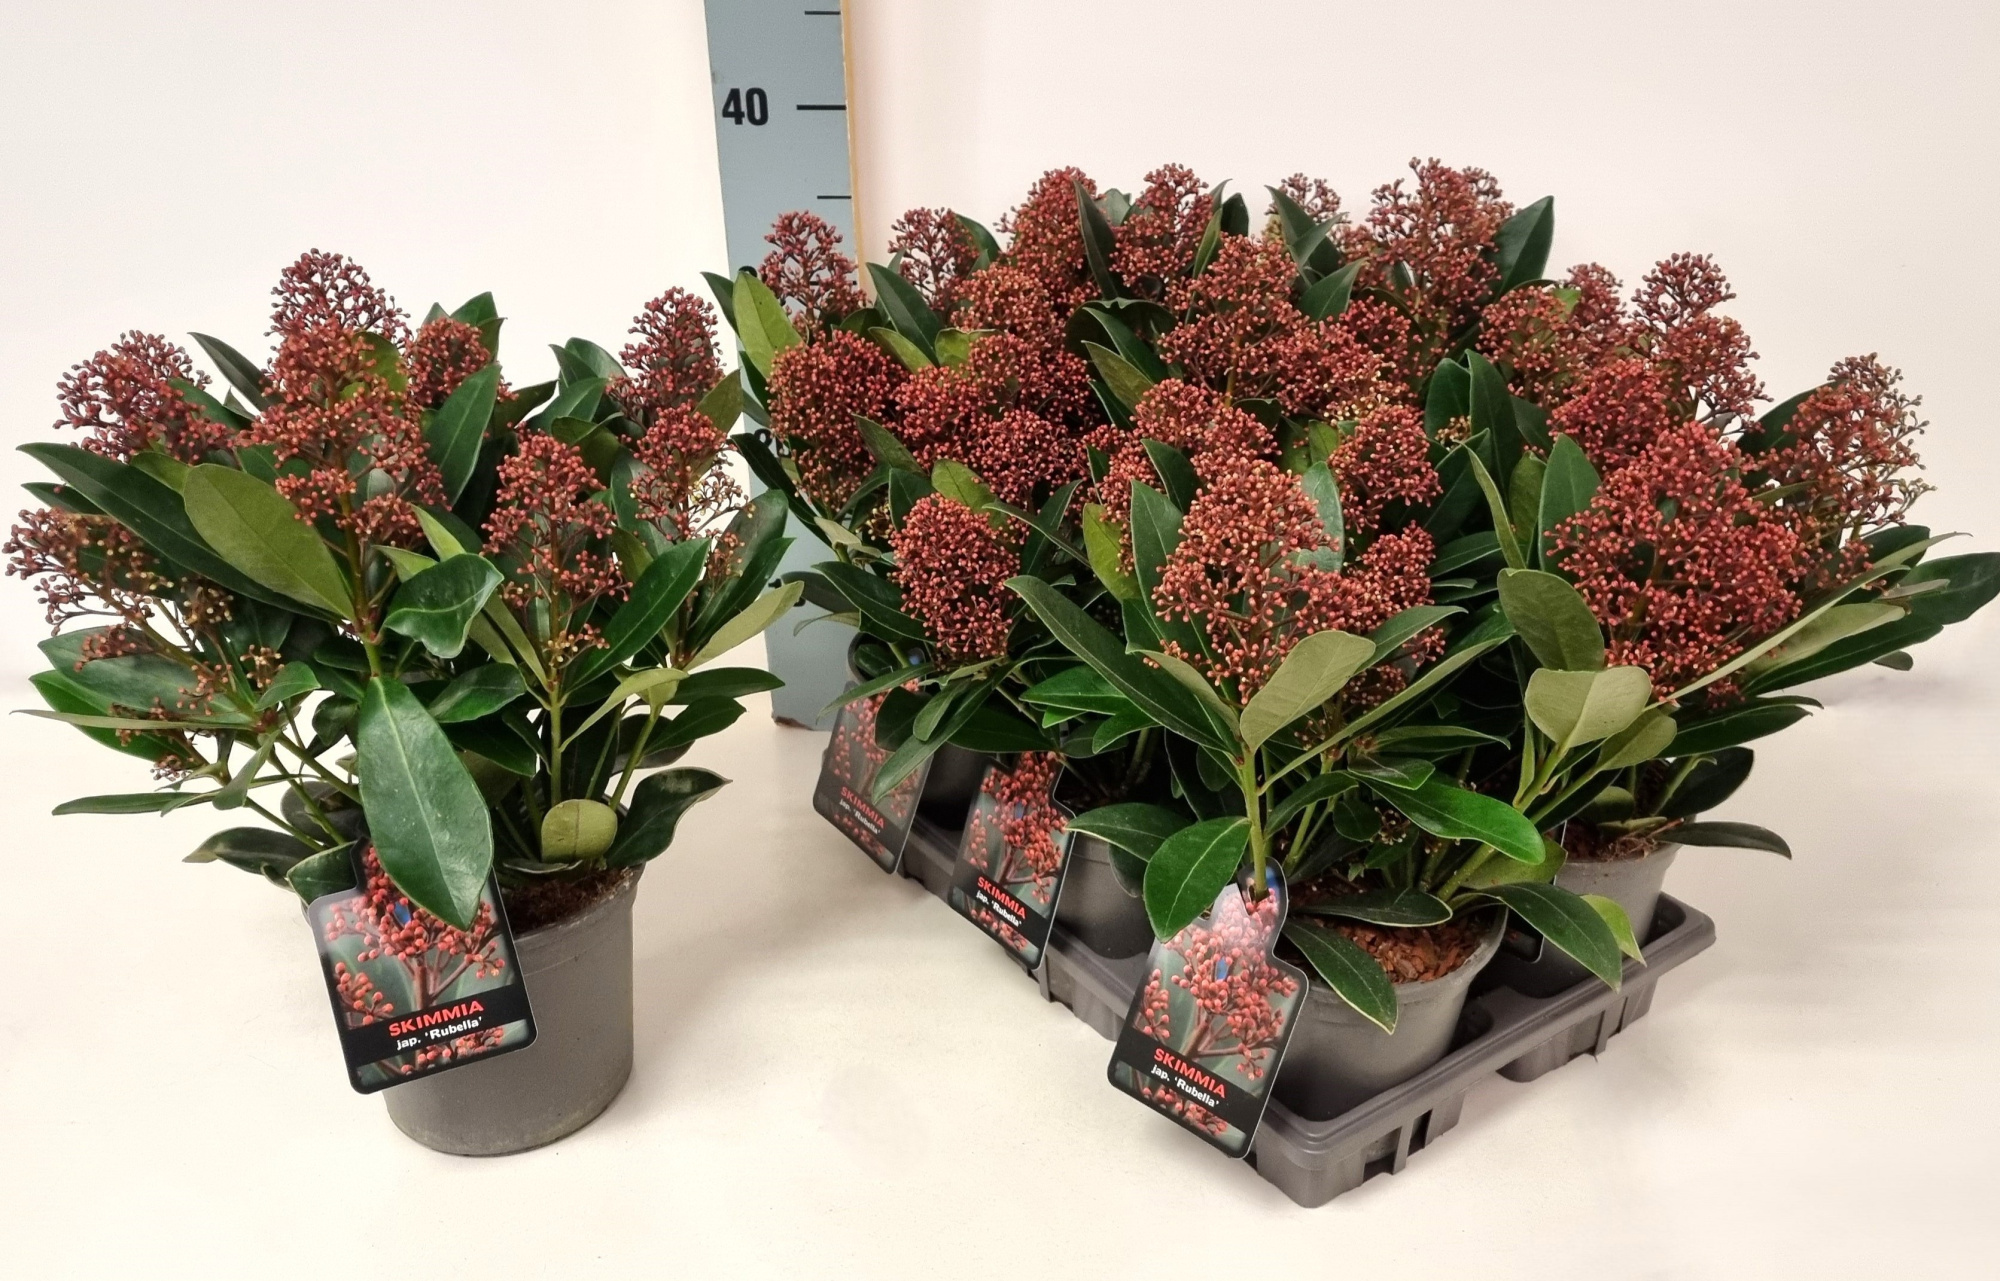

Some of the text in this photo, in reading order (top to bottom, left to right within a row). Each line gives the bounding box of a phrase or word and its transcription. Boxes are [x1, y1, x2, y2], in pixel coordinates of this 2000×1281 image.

[721, 87, 769, 126] 40
[841, 786, 885, 829] SKIMMIA
[977, 876, 1026, 920] SKIMMIA
[388, 1000, 485, 1037] SKIMMIA
[396, 1037, 421, 1051] jap.
[1151, 1064, 1170, 1082] jap.
[1154, 1048, 1226, 1098] SKIMMIA
